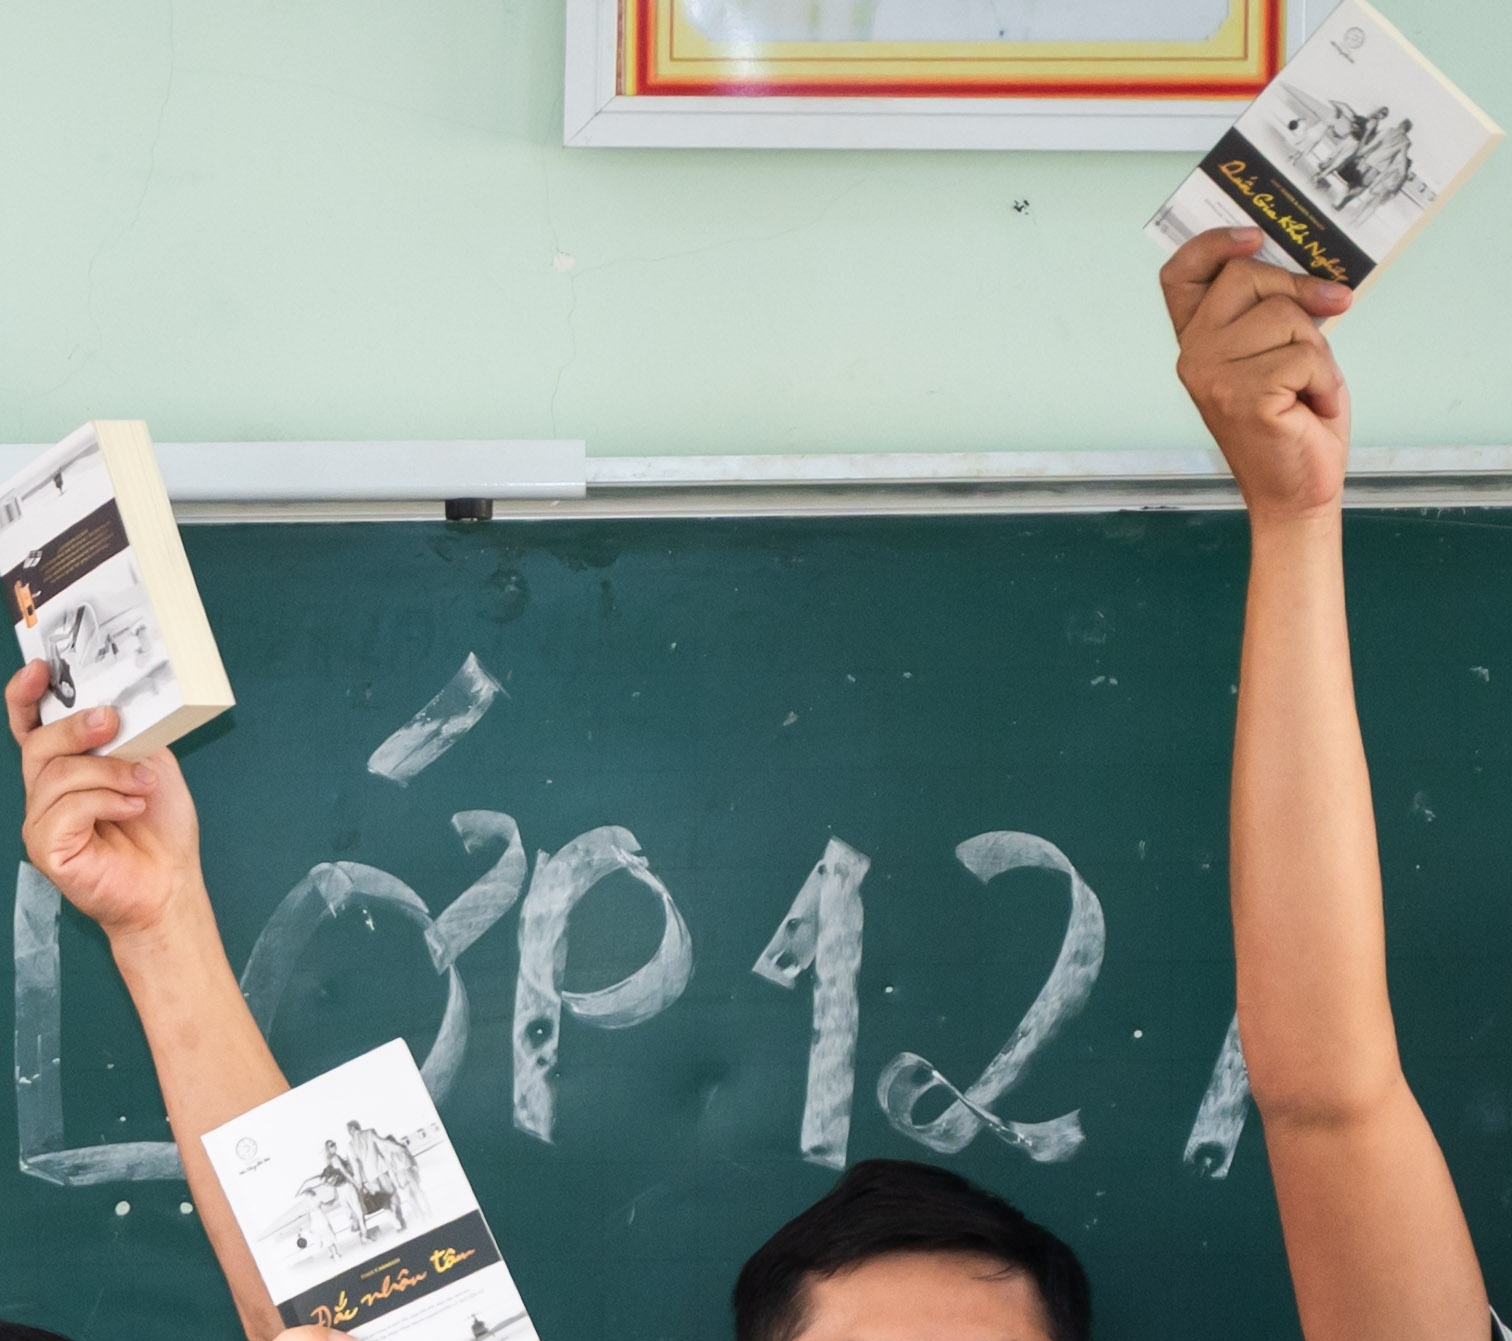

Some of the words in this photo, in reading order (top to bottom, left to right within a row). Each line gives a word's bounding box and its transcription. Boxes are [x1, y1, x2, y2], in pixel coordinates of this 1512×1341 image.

[1252, 193, 1279, 220] Gia
[360, 1268, 428, 1306] nhân
[430, 1247, 475, 1273] tâm
